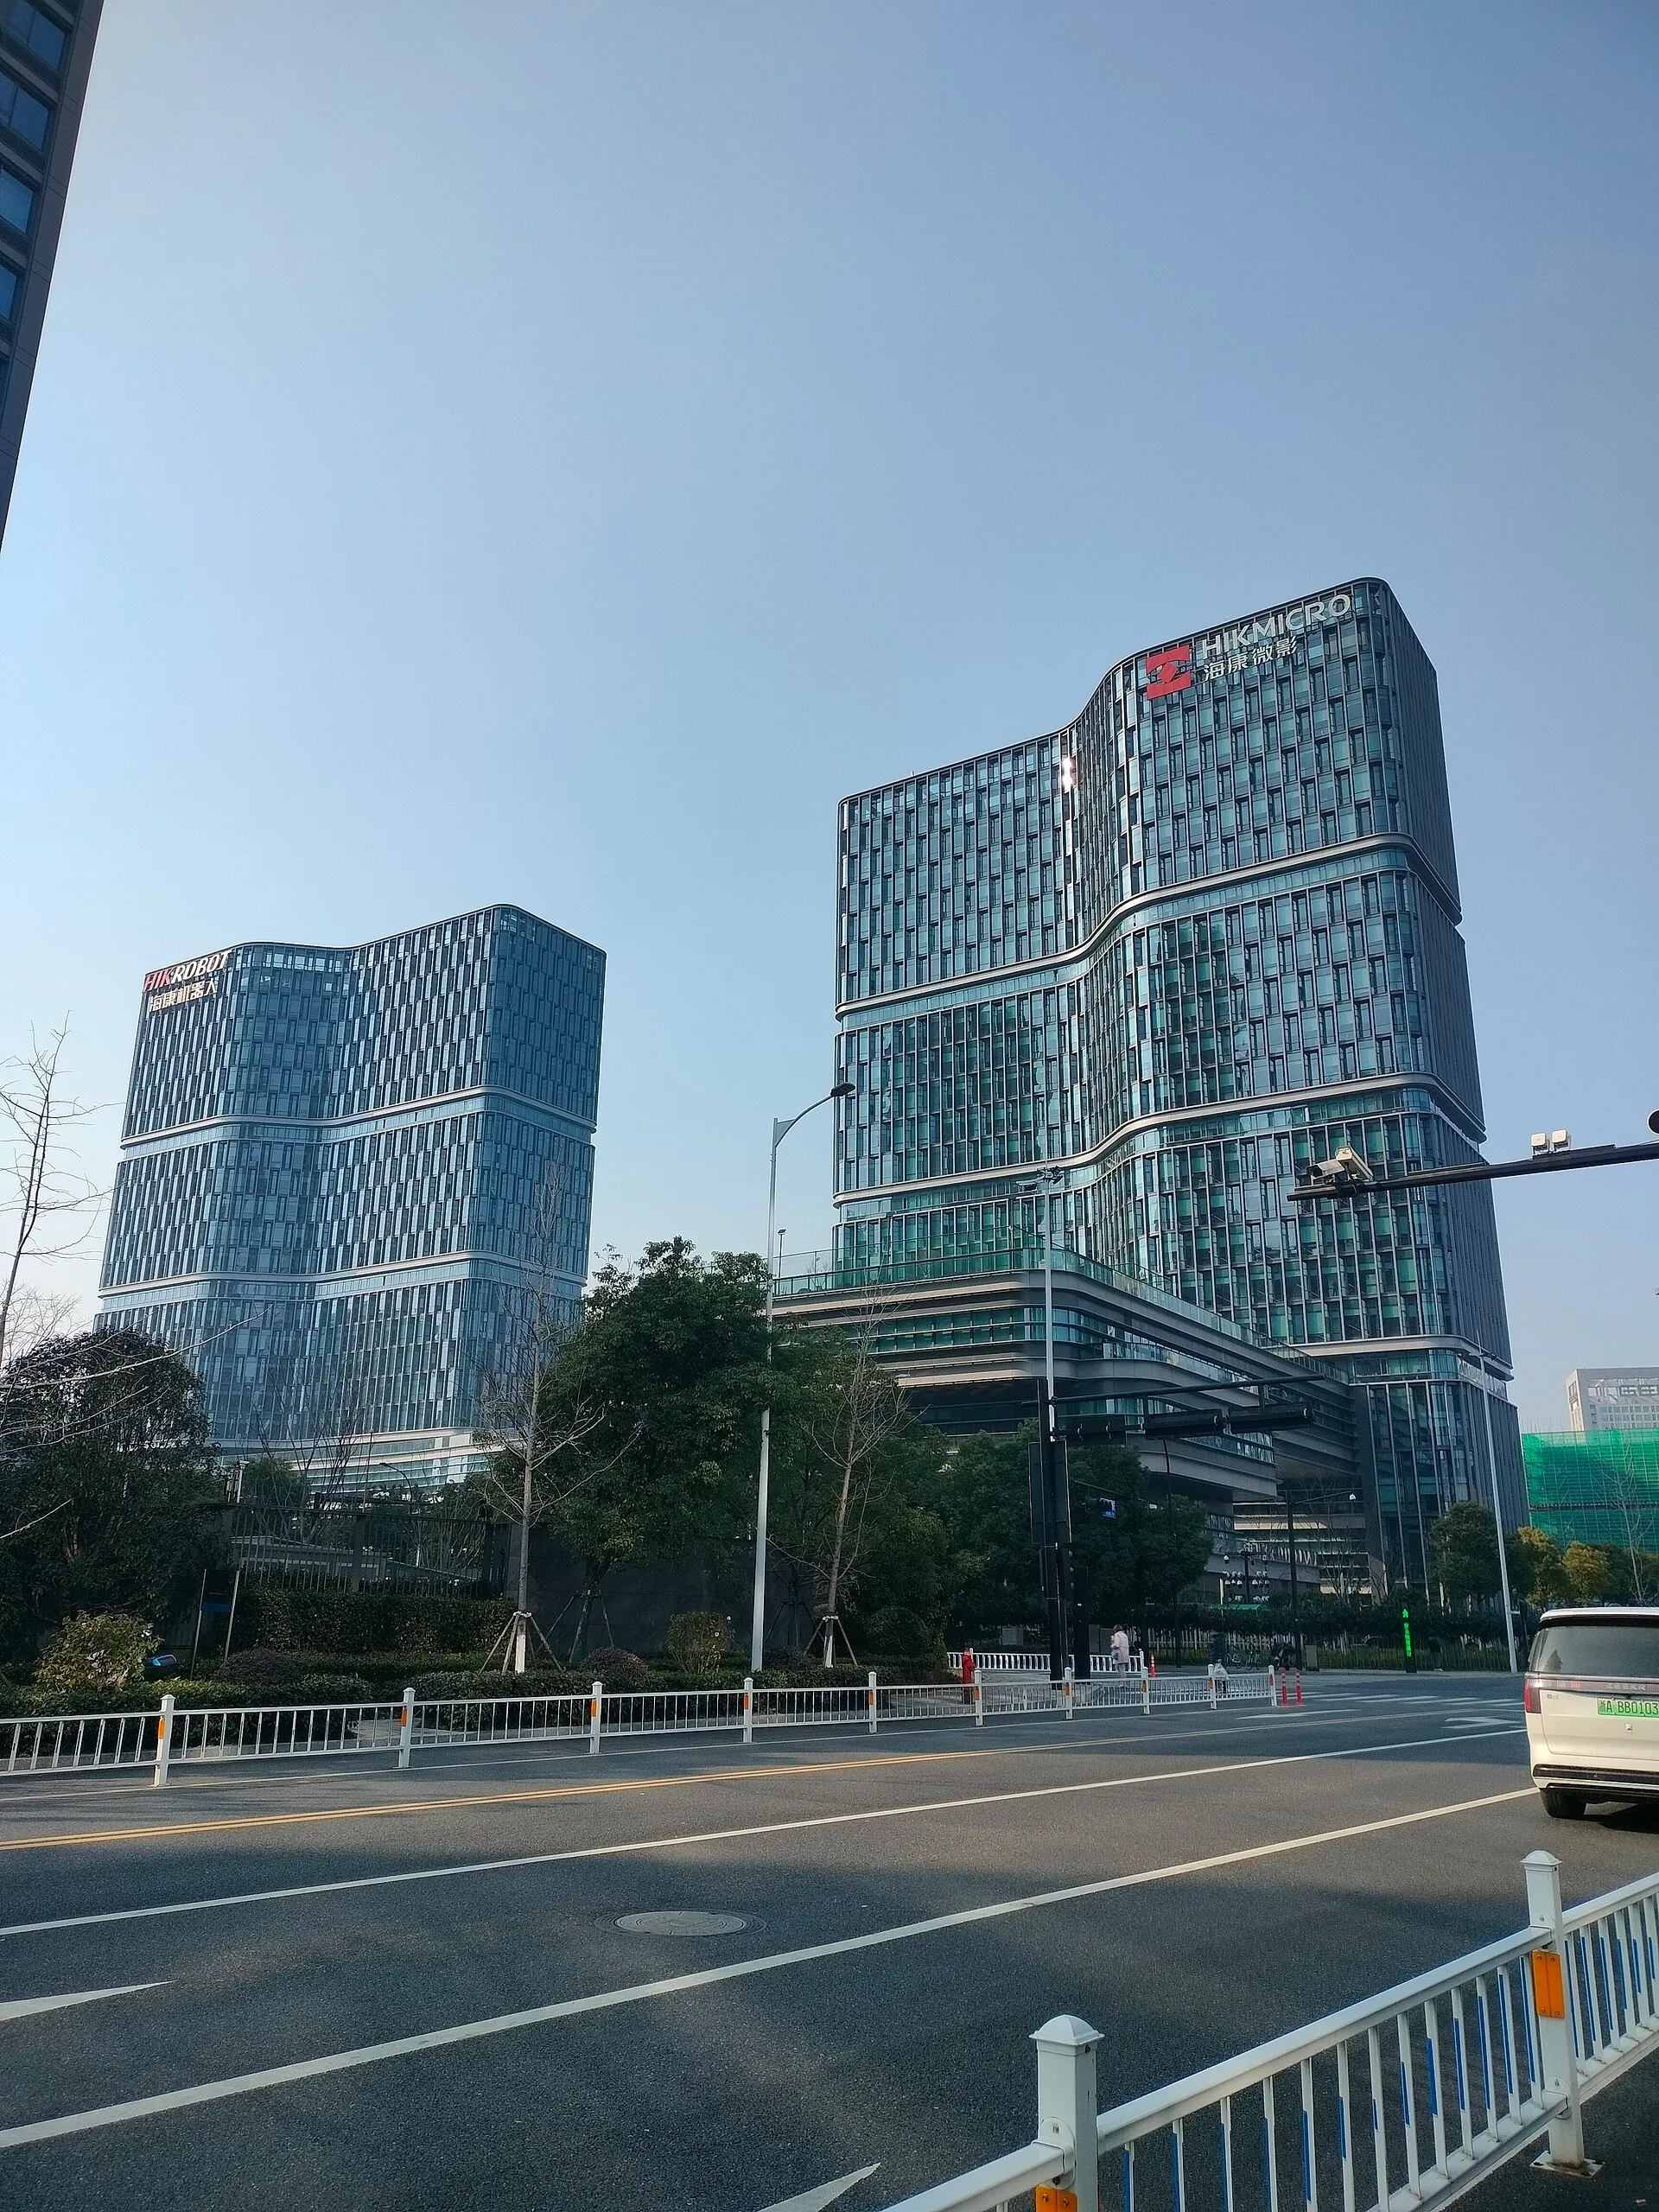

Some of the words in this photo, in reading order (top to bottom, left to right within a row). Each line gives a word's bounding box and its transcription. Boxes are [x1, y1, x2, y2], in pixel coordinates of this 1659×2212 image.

[1202, 594, 1351, 659] HIKMICRO
[1203, 635, 1298, 681] 海康微影
[143, 950, 232, 992] HIKROBOT
[149, 978, 218, 1013] 海康机器人
